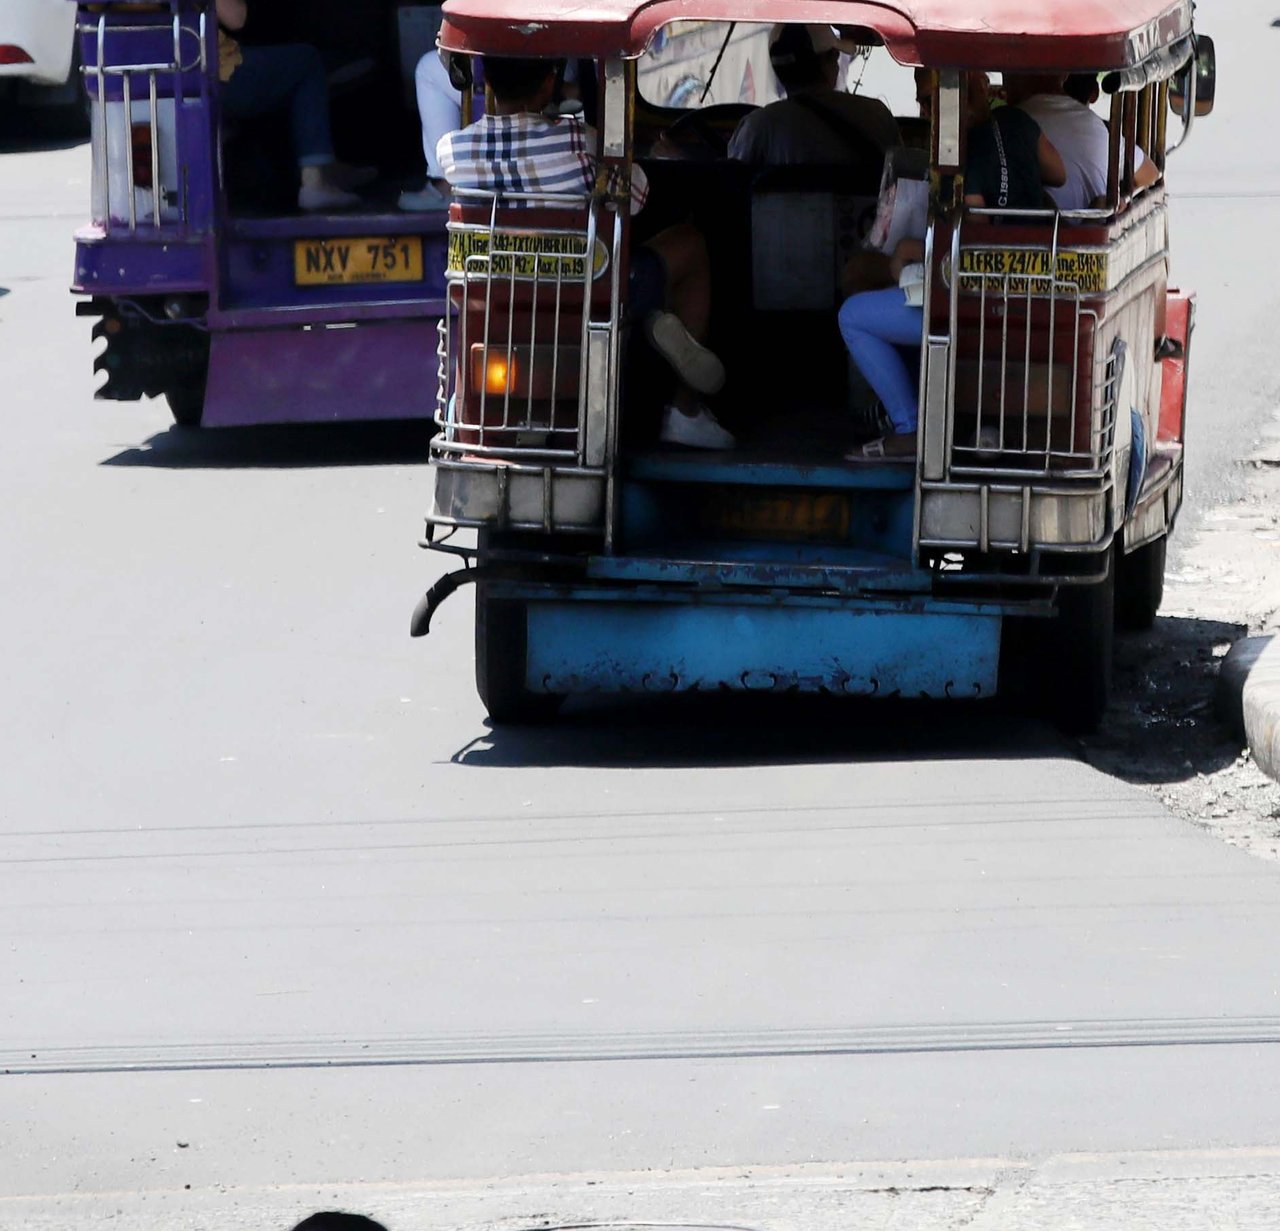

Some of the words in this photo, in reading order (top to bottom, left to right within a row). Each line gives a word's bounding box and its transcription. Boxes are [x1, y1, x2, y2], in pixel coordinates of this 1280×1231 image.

[306, 245, 350, 274] NXV
[367, 243, 411, 271] 751
[960, 252, 1005, 273] LTFRB
